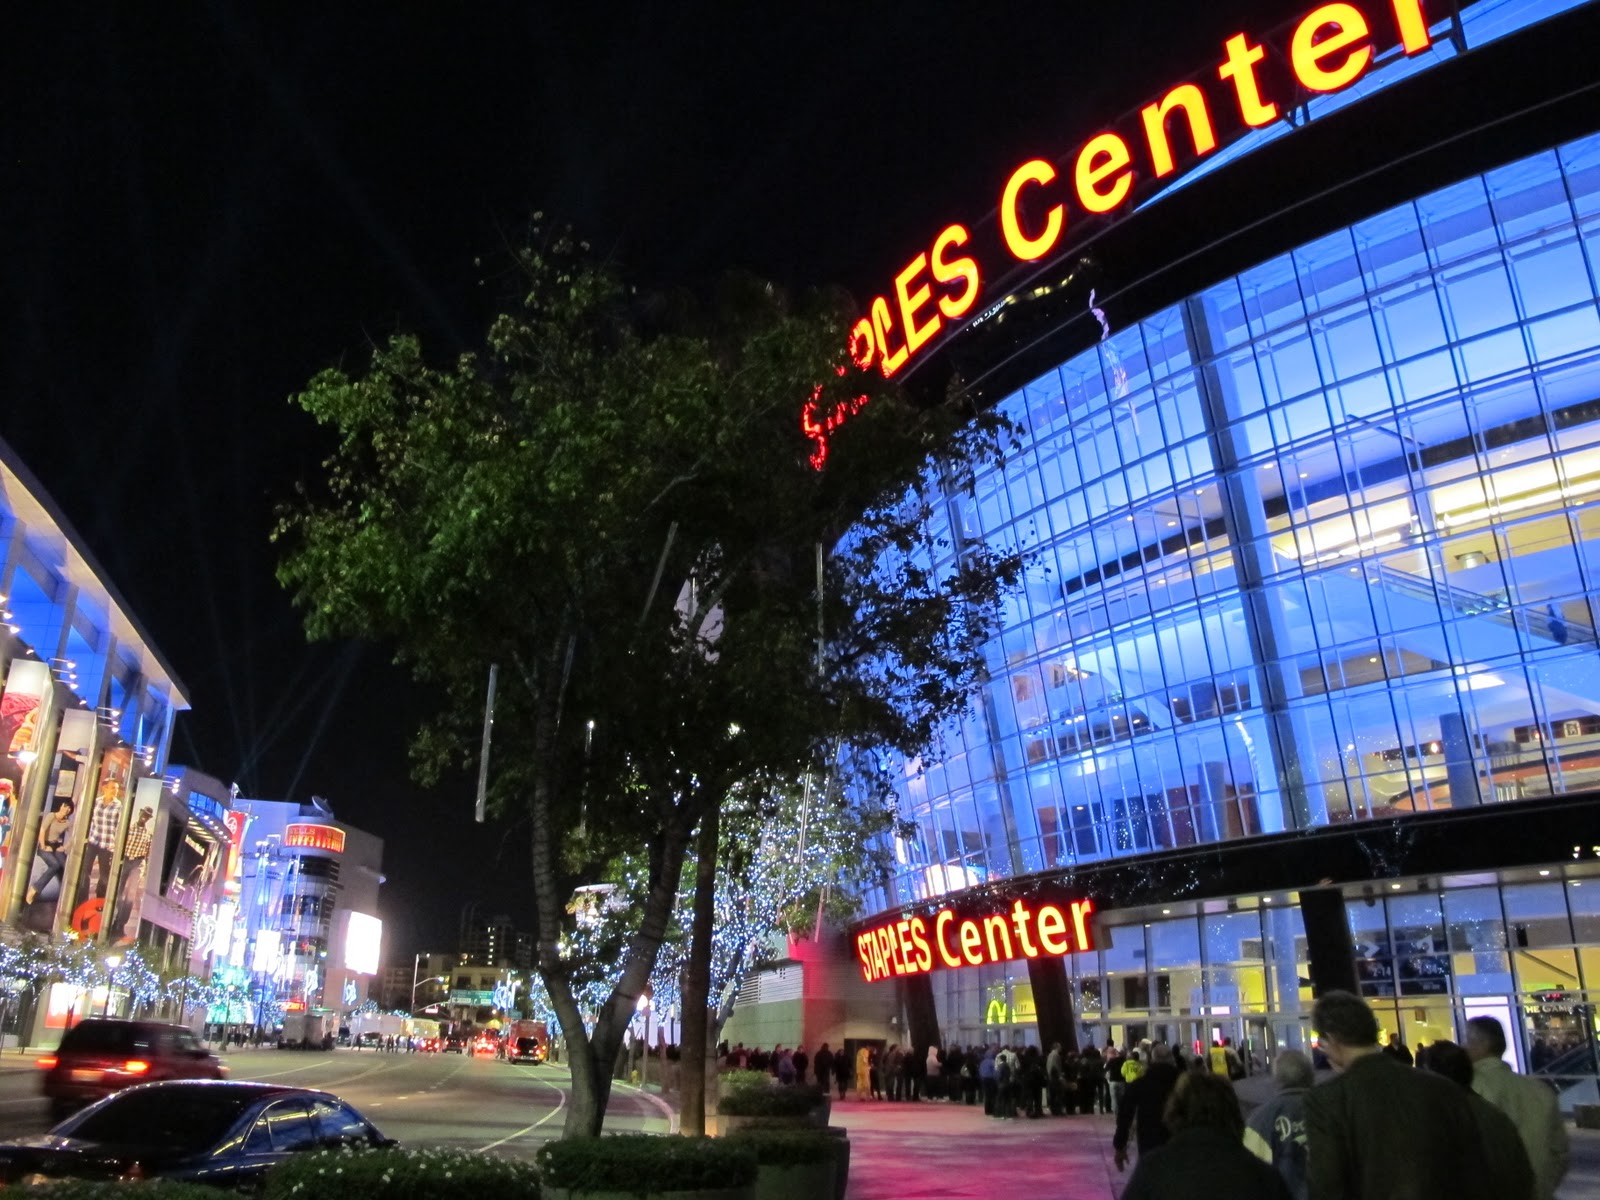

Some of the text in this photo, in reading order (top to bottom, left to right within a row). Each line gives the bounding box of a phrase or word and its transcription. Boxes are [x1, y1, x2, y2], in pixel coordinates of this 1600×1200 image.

[802, 224, 980, 471] SPLES
[857, 898, 1092, 982] STAPLES Center
